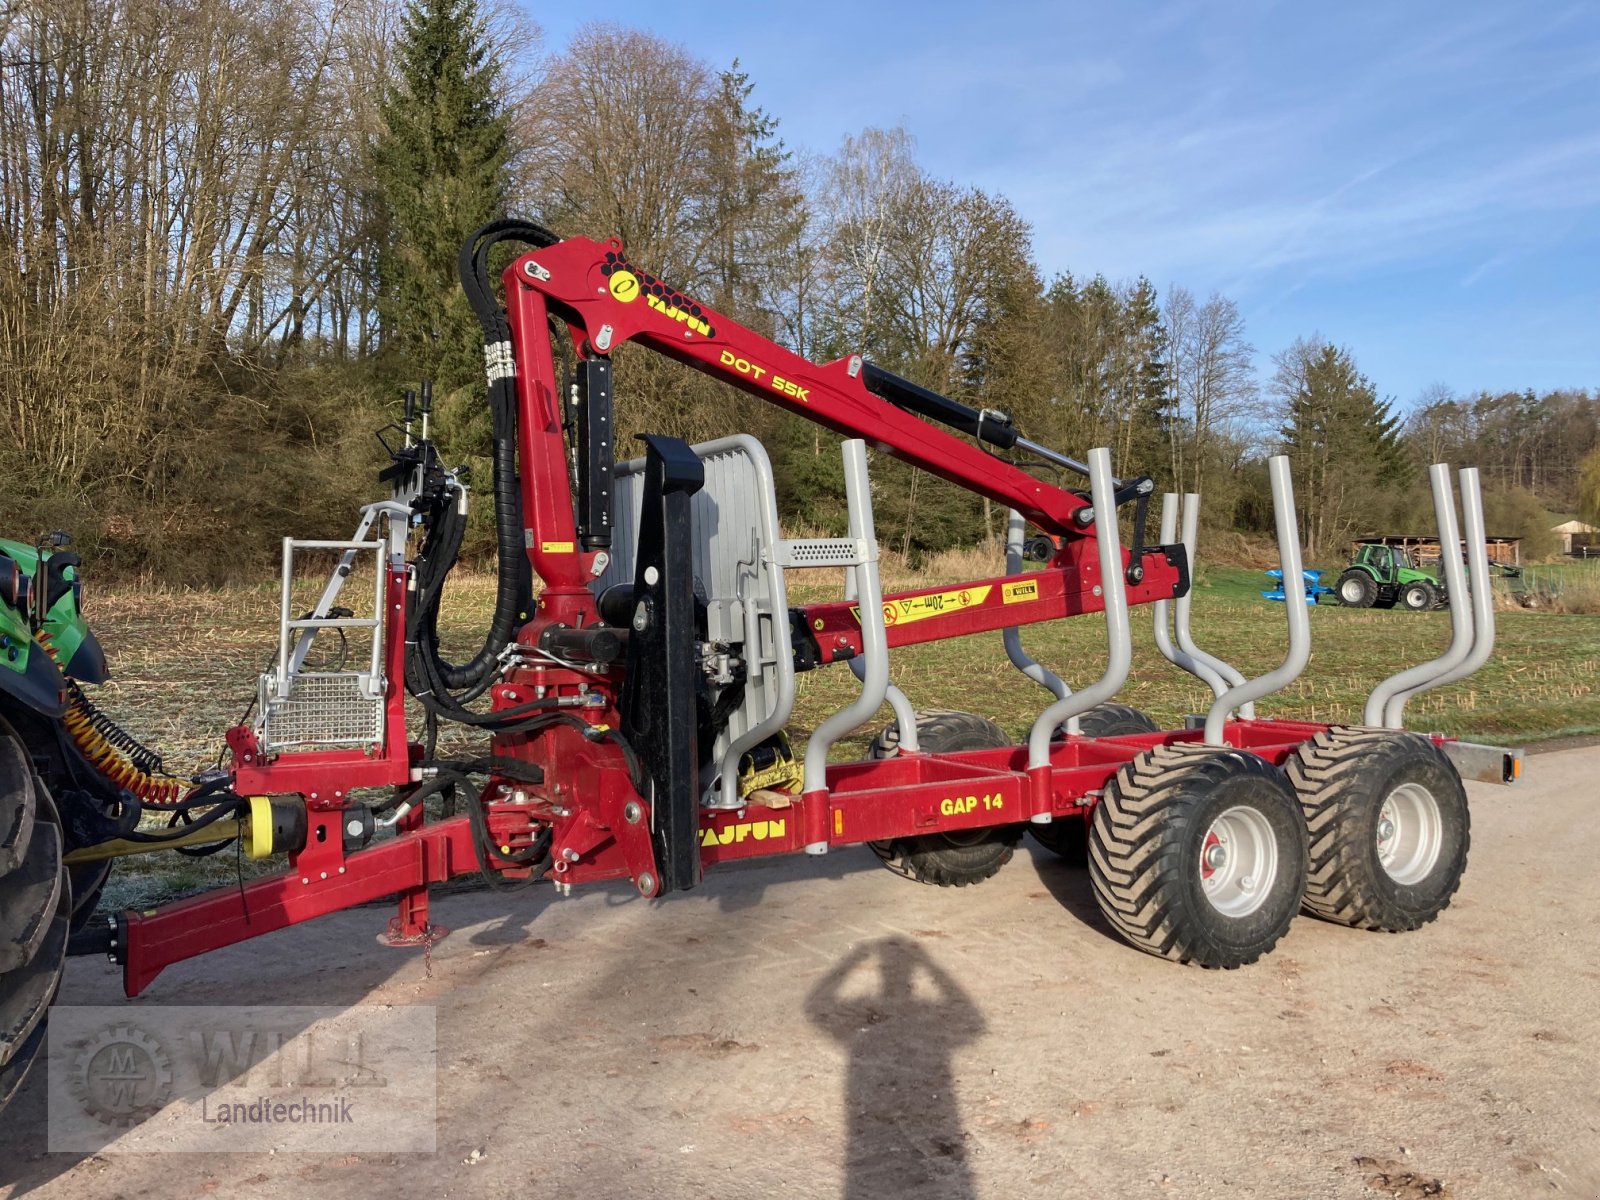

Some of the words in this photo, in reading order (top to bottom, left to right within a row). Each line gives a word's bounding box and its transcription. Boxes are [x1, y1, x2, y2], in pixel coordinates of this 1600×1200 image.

[646, 293, 712, 337] TAJFUN
[719, 350, 766, 380] DOT
[1015, 586, 1034, 595] WILL
[924, 595, 944, 610] 20m
[940, 796, 978, 816] GAP
[983, 793, 1004, 810] 14
